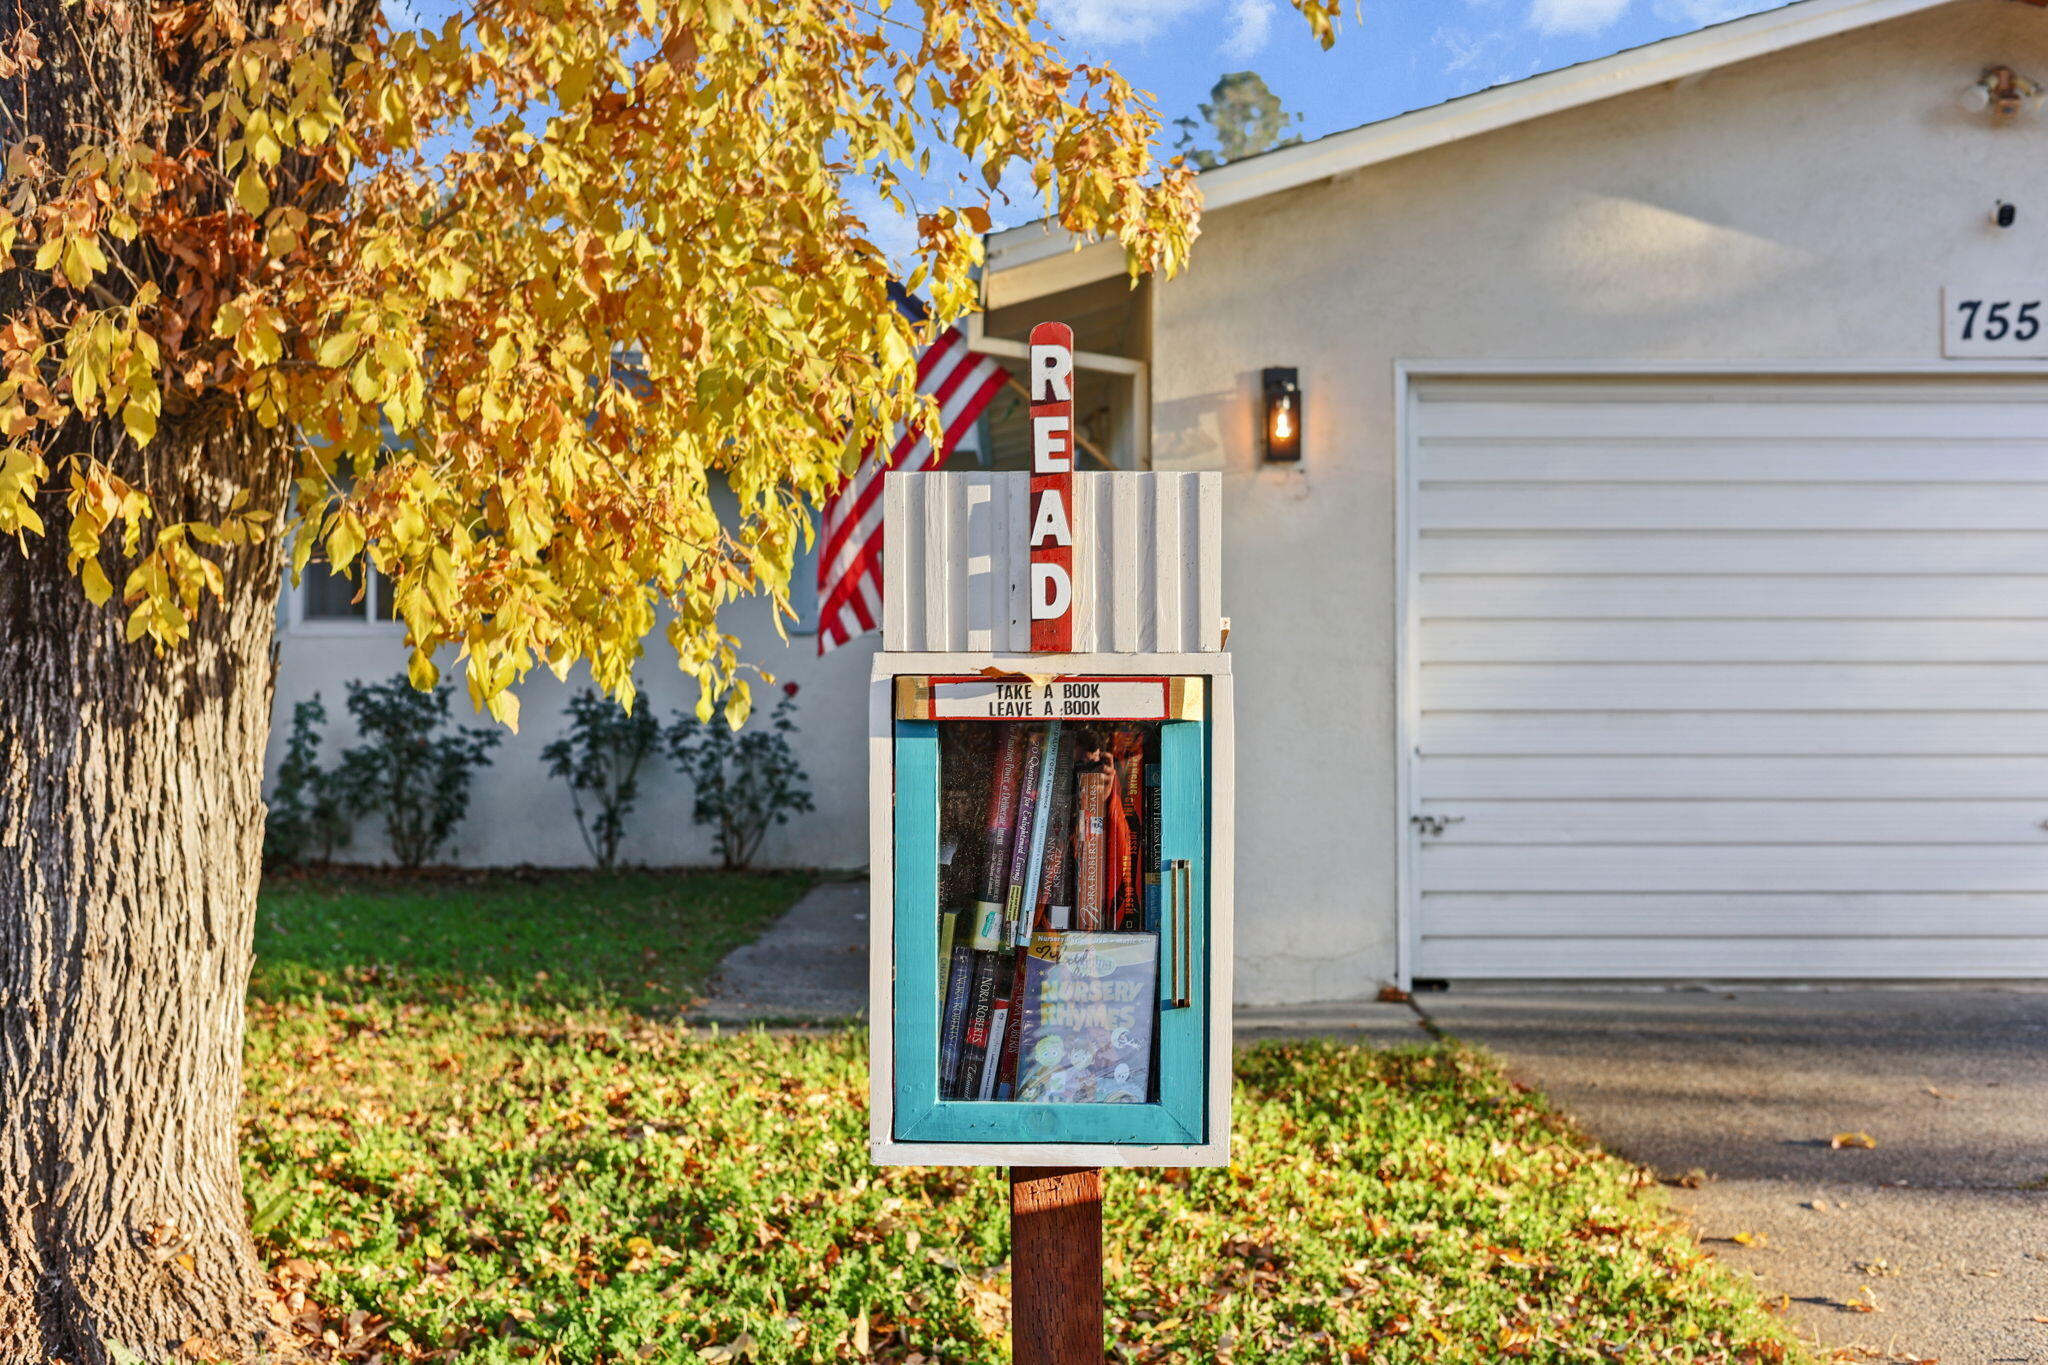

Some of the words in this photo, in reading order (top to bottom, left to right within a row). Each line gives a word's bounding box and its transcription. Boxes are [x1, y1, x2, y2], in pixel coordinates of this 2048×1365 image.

[1958, 300, 2041, 341] 755
[1030, 344, 1072, 620] READ
[996, 684, 1033, 700] TAKE
[1043, 684, 1054, 699] A
[1063, 683, 1100, 699] BOOK
[989, 701, 1033, 717] LEAVE
[1043, 701, 1054, 716] A
[1064, 701, 1100, 716] BOOK
[1004, 735, 1016, 762] Amazing
[1031, 740, 1040, 754] 20
[1003, 764, 1014, 783] Power
[1025, 756, 1040, 795] Questions
[1047, 757, 1056, 777] YOGA
[1022, 797, 1034, 808] for
[1042, 779, 1052, 809] Experience
[1089, 784, 1097, 814] STARS
[1153, 787, 1161, 810] MARY
[998, 792, 1012, 825] Deliberate
[996, 827, 1007, 845] Intent
[1017, 810, 1032, 854] Enlightened
[1153, 812, 1161, 843] HIGGINS
[1046, 837, 1056, 863] ANN
[1087, 834, 1097, 883] ROBERTS
[1153, 844, 1161, 870] CLARK
[1012, 856, 1025, 882] Living
[1042, 864, 1056, 898] JAYNE
[1053, 847, 1063, 888] KRENTZ
[1080, 885, 1099, 927] NORA
[954, 976, 966, 1000] NORA
[979, 977, 993, 1002] NORA
[1041, 980, 1144, 1002] NURSERY
[948, 1002, 962, 1040] ROBERTS
[971, 1005, 988, 1044] ROBERTS
[1007, 1018, 1021, 1054] ROBERTS
